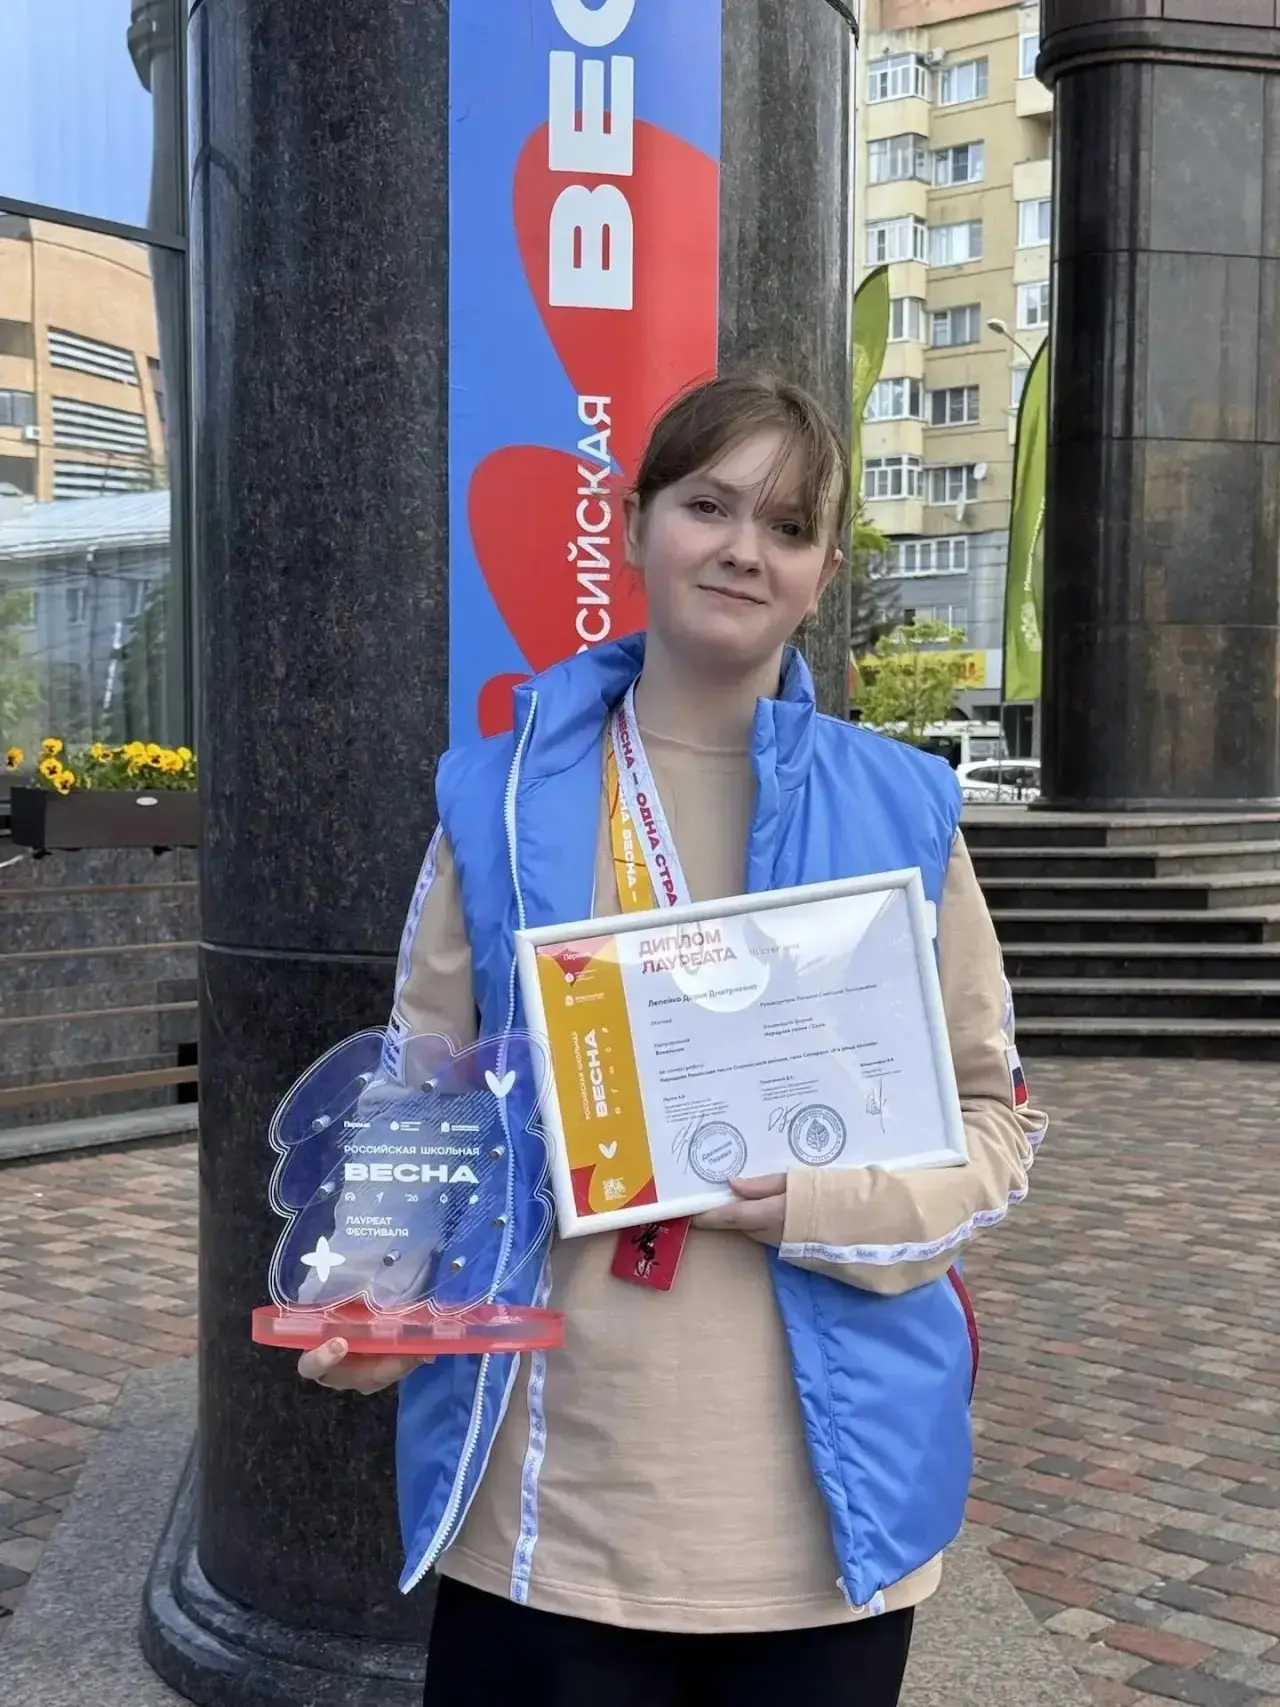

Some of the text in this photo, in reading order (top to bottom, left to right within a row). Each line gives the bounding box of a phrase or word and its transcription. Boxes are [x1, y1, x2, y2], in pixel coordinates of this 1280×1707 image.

[566, 394, 612, 655] СИЙСКАЯ
[622, 828, 637, 888] ВЕСНА
[636, 792, 660, 850] ОДНА
[655, 853, 678, 907] СТРА
[638, 929, 722, 957] ДИПЛОМ
[641, 947, 738, 974] ЛАУРЕАТА
[584, 1027, 608, 1118] ВЕСНА
[344, 1145, 480, 1156] РОССИЙСКАЯ ШКОЛЬНАЯ
[344, 1163, 480, 1183] ВЕСНА
[346, 1216, 393, 1226] ЛАУРЕАТ
[346, 1227, 409, 1237] ФЕСТИВАЛЯ
